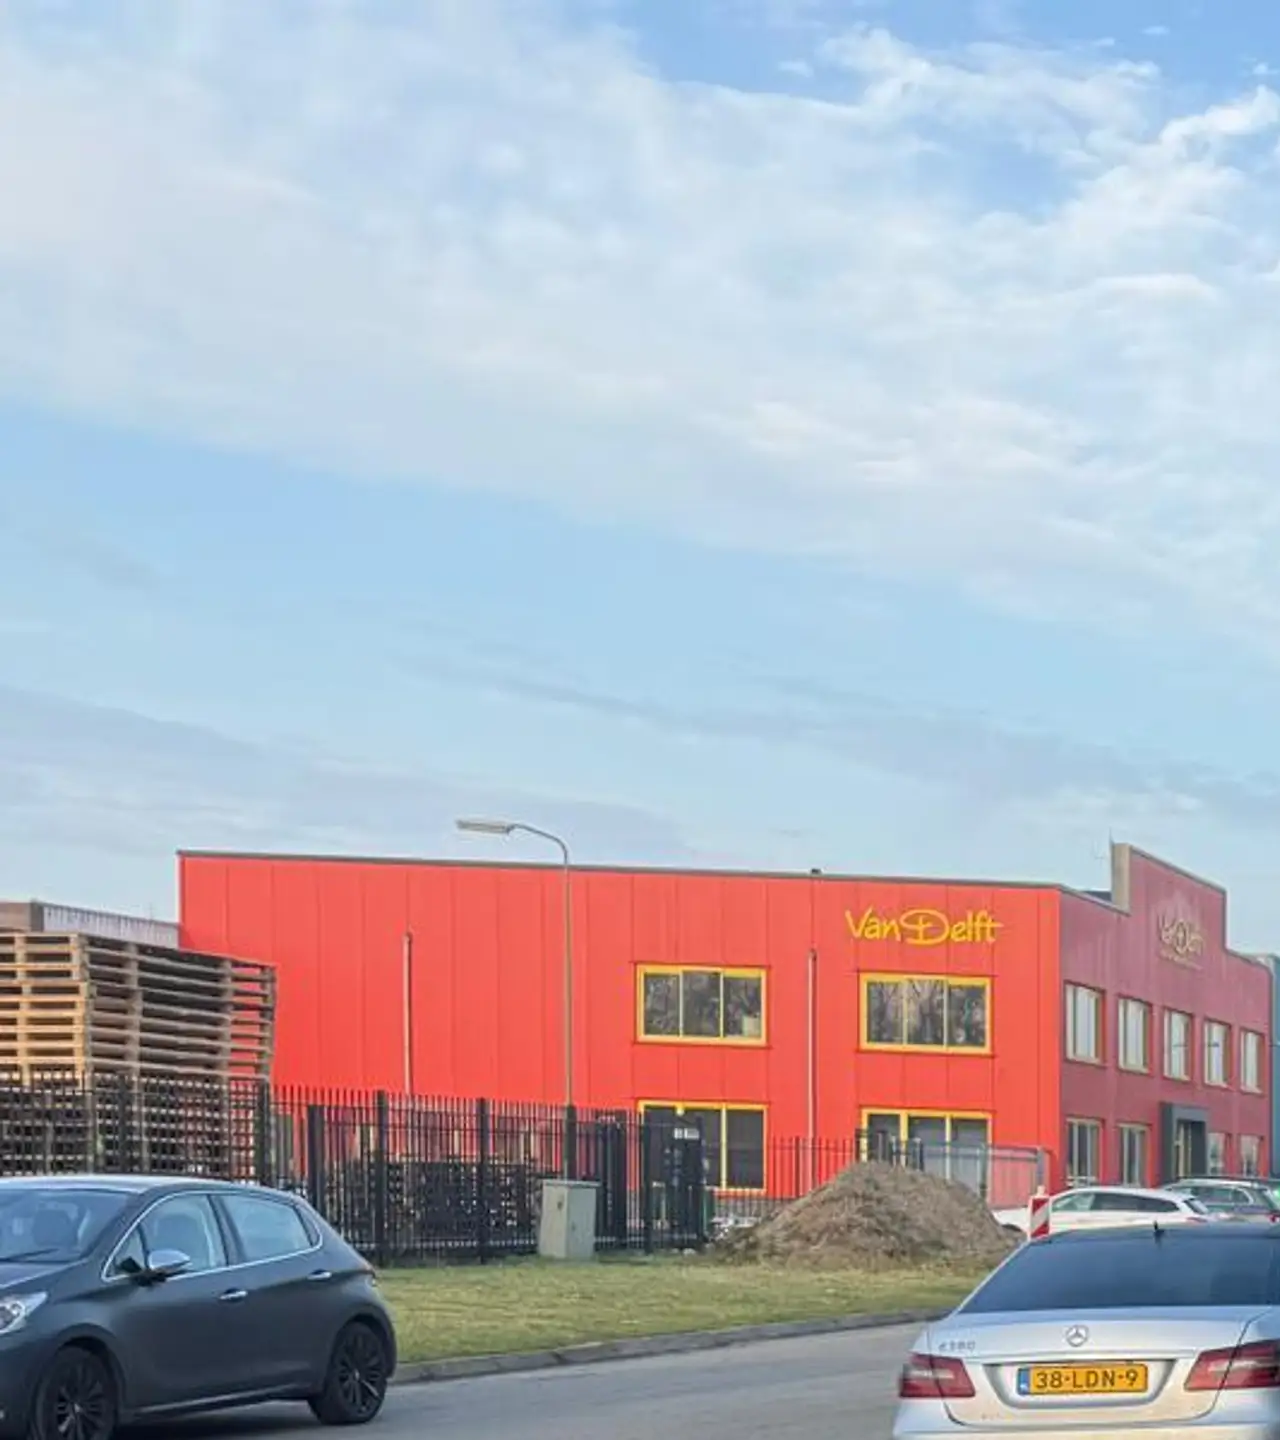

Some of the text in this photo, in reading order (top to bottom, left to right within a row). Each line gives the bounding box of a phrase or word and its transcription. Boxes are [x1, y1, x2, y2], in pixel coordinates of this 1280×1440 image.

[844, 904, 1005, 946] Van Delft
[1035, 1367, 1139, 1390] 38-LDN-9
